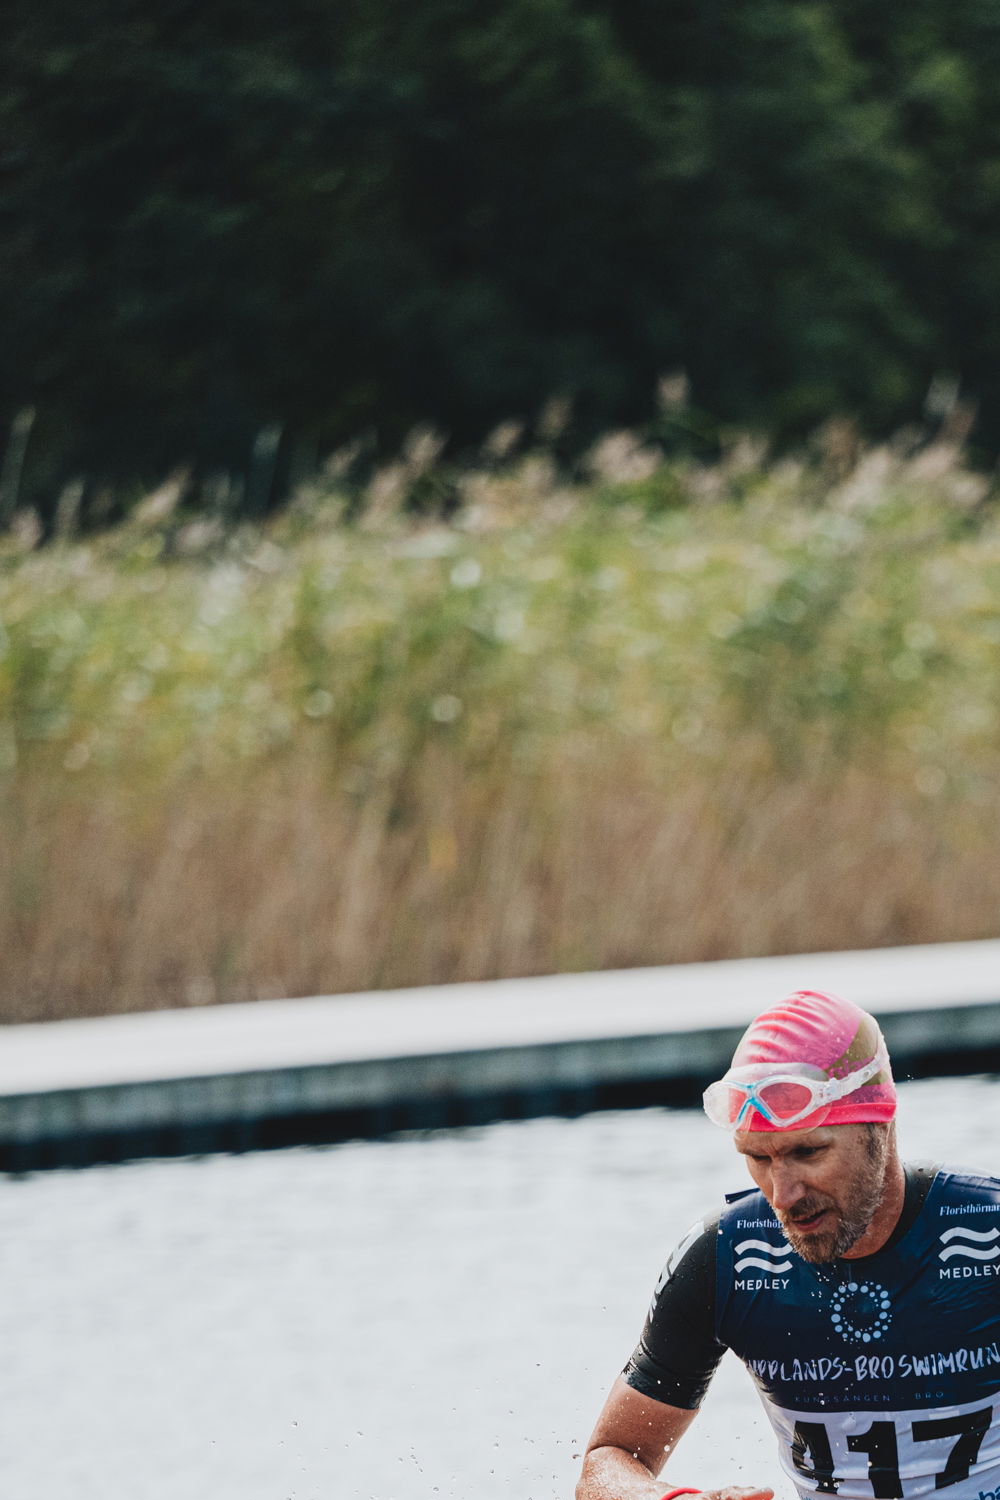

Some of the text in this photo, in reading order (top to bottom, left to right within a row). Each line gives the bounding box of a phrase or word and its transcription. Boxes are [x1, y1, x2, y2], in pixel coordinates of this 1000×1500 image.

[734, 1279, 790, 1290] MEDLEY
[939, 1265, 1000, 1279] MEDLEY
[898, 1342, 1000, 1378] SWIMRUN
[791, 1405, 993, 1499] 417
